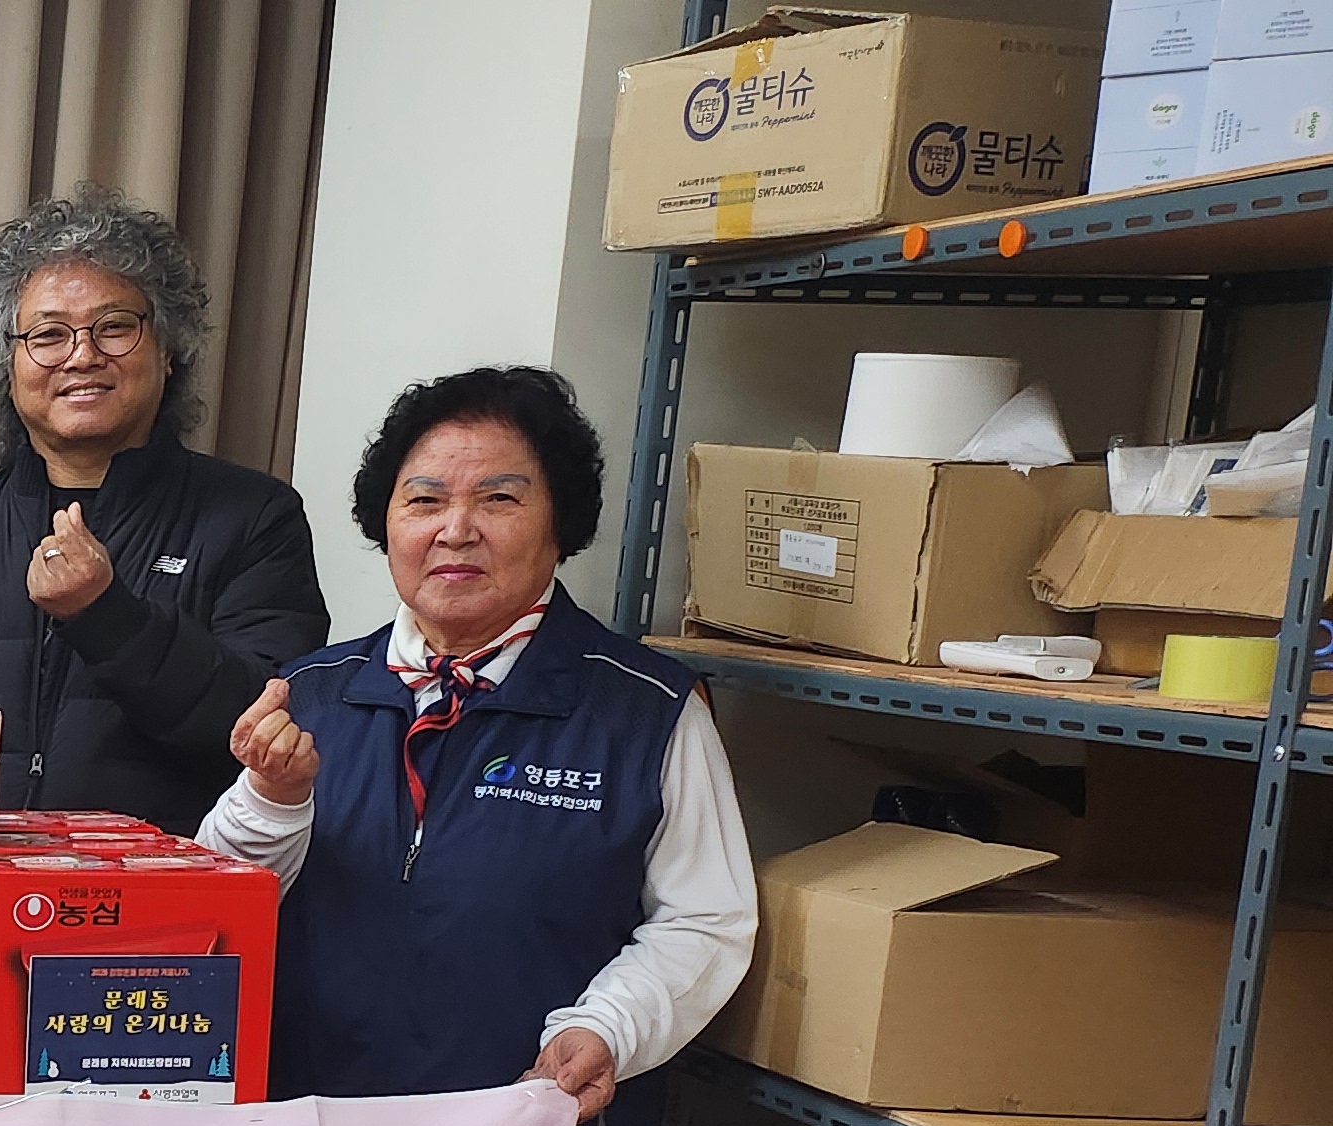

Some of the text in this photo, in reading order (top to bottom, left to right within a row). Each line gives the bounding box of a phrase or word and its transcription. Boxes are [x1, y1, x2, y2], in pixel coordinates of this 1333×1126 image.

[733, 67, 815, 115] 물티슈
[696, 113, 715, 126] 나라
[971, 131, 1064, 180] 물티슈
[923, 162, 948, 178] 나라
[524, 764, 602, 791] 영등포구
[473, 785, 602, 812] 동지역사회보장협의체
[55, 900, 120, 927] 농심
[105, 990, 169, 1009] 문래동
[45, 1015, 211, 1033] 사랑의 온기나눔
[82, 1058, 190, 1068] 문래동 지역사회보장협의체
